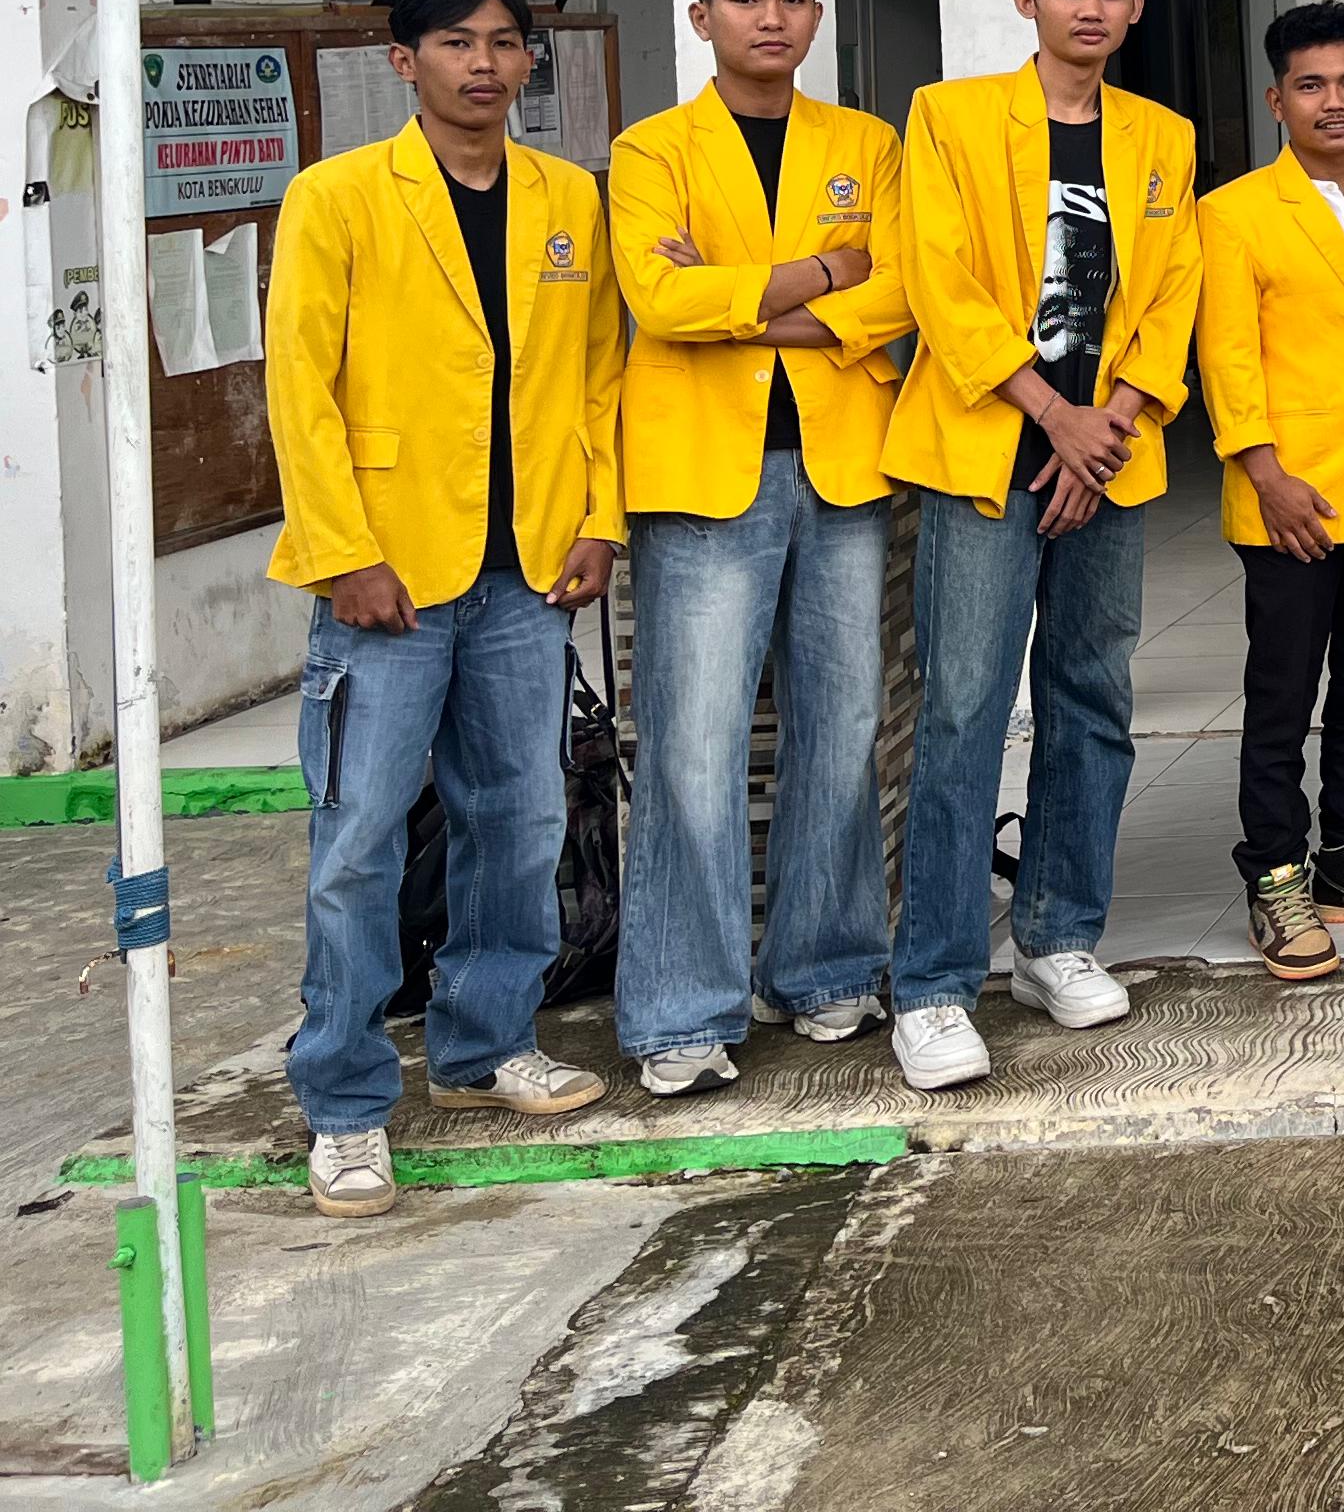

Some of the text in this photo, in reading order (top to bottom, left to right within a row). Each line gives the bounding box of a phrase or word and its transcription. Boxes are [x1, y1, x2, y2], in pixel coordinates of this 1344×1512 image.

[176, 63, 252, 92] SEKRETARIAT
[59, 101, 90, 131] POS
[182, 98, 253, 129] KELURAHAN
[252, 97, 290, 125] SEHAT
[157, 137, 285, 170] KELURAHAN PINTU BATU
[177, 176, 264, 201] KOTA BENGKULU
